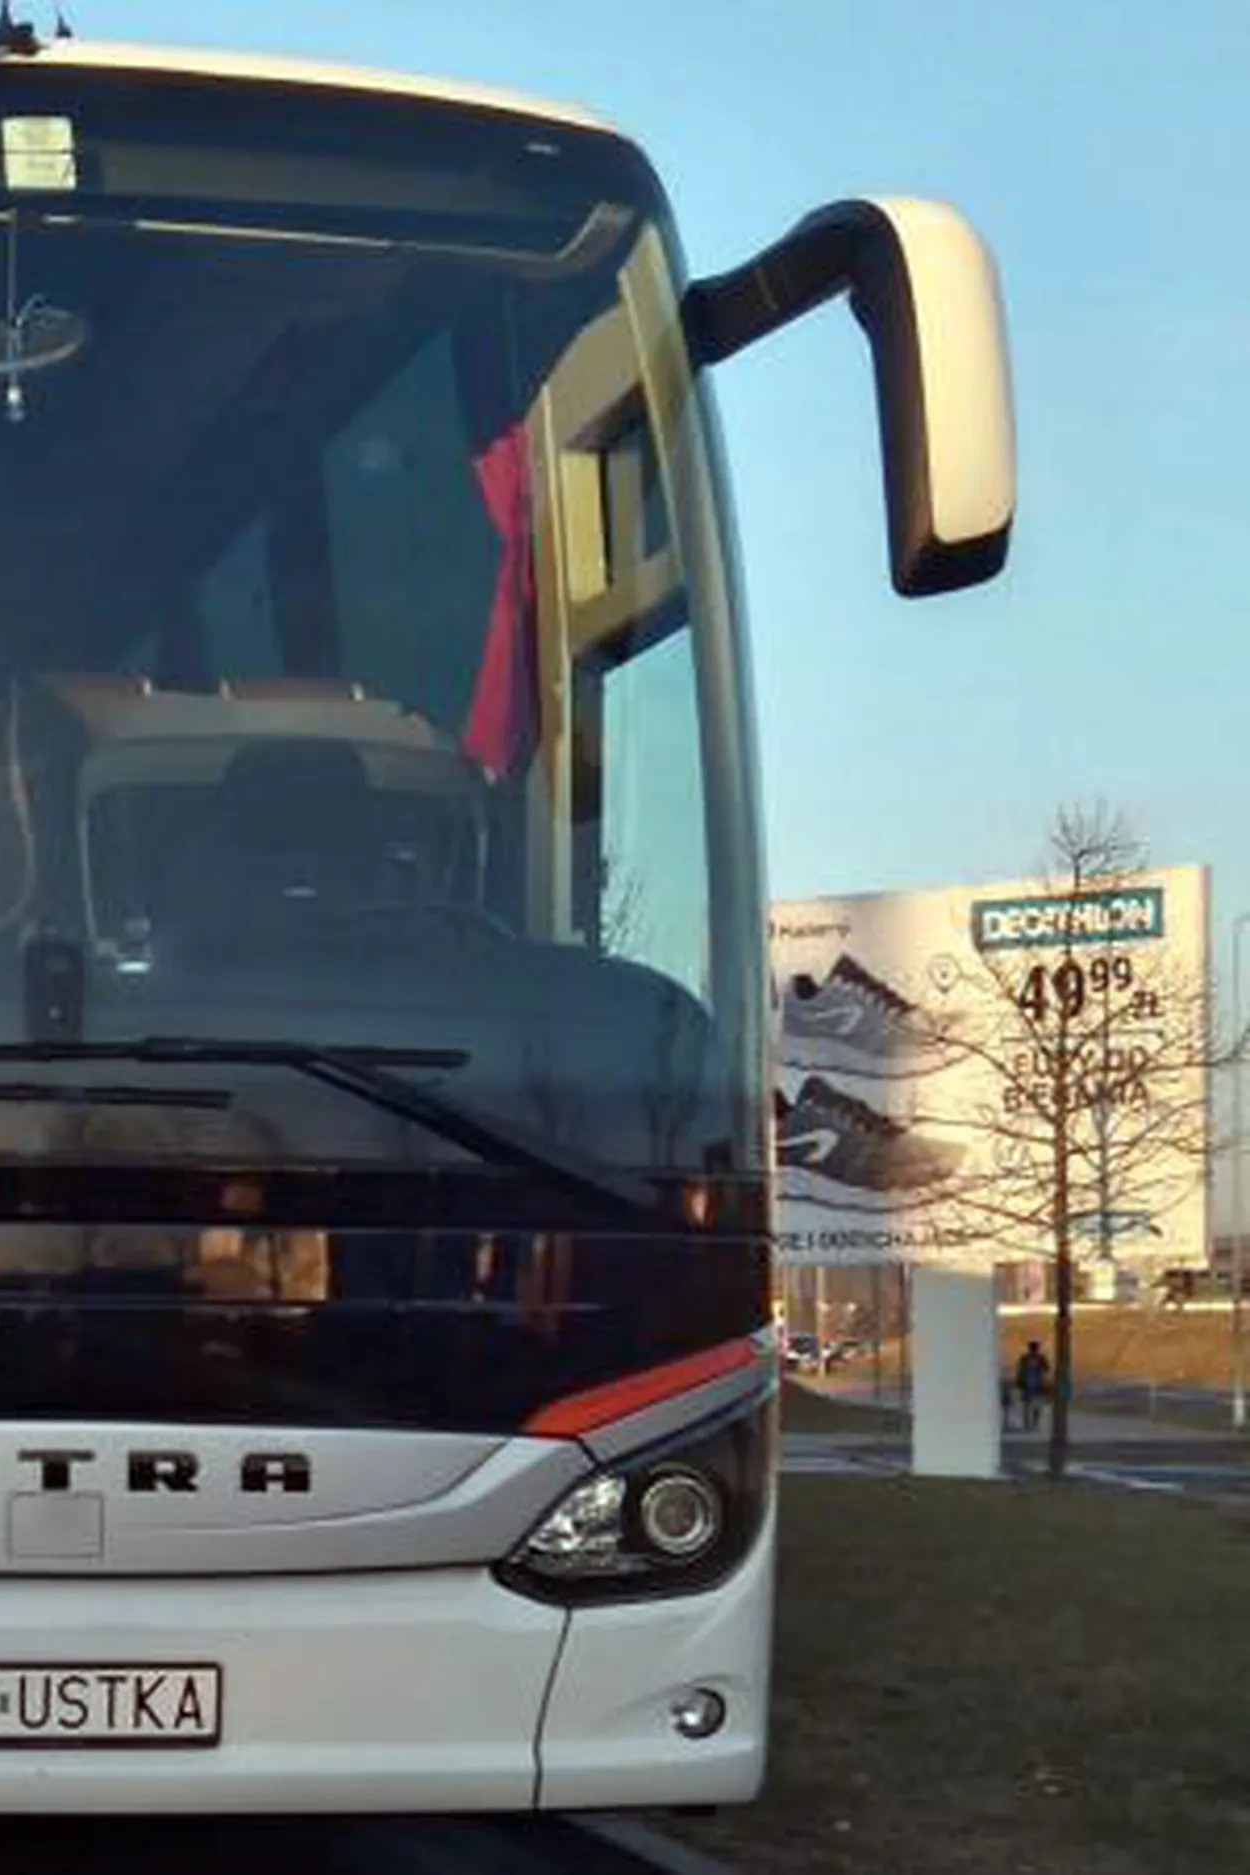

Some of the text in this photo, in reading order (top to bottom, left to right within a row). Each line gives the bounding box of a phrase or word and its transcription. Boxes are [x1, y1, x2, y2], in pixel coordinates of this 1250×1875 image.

[1018, 956, 1133, 1021] 49 99
[19, 1674, 206, 1730] USTKA
